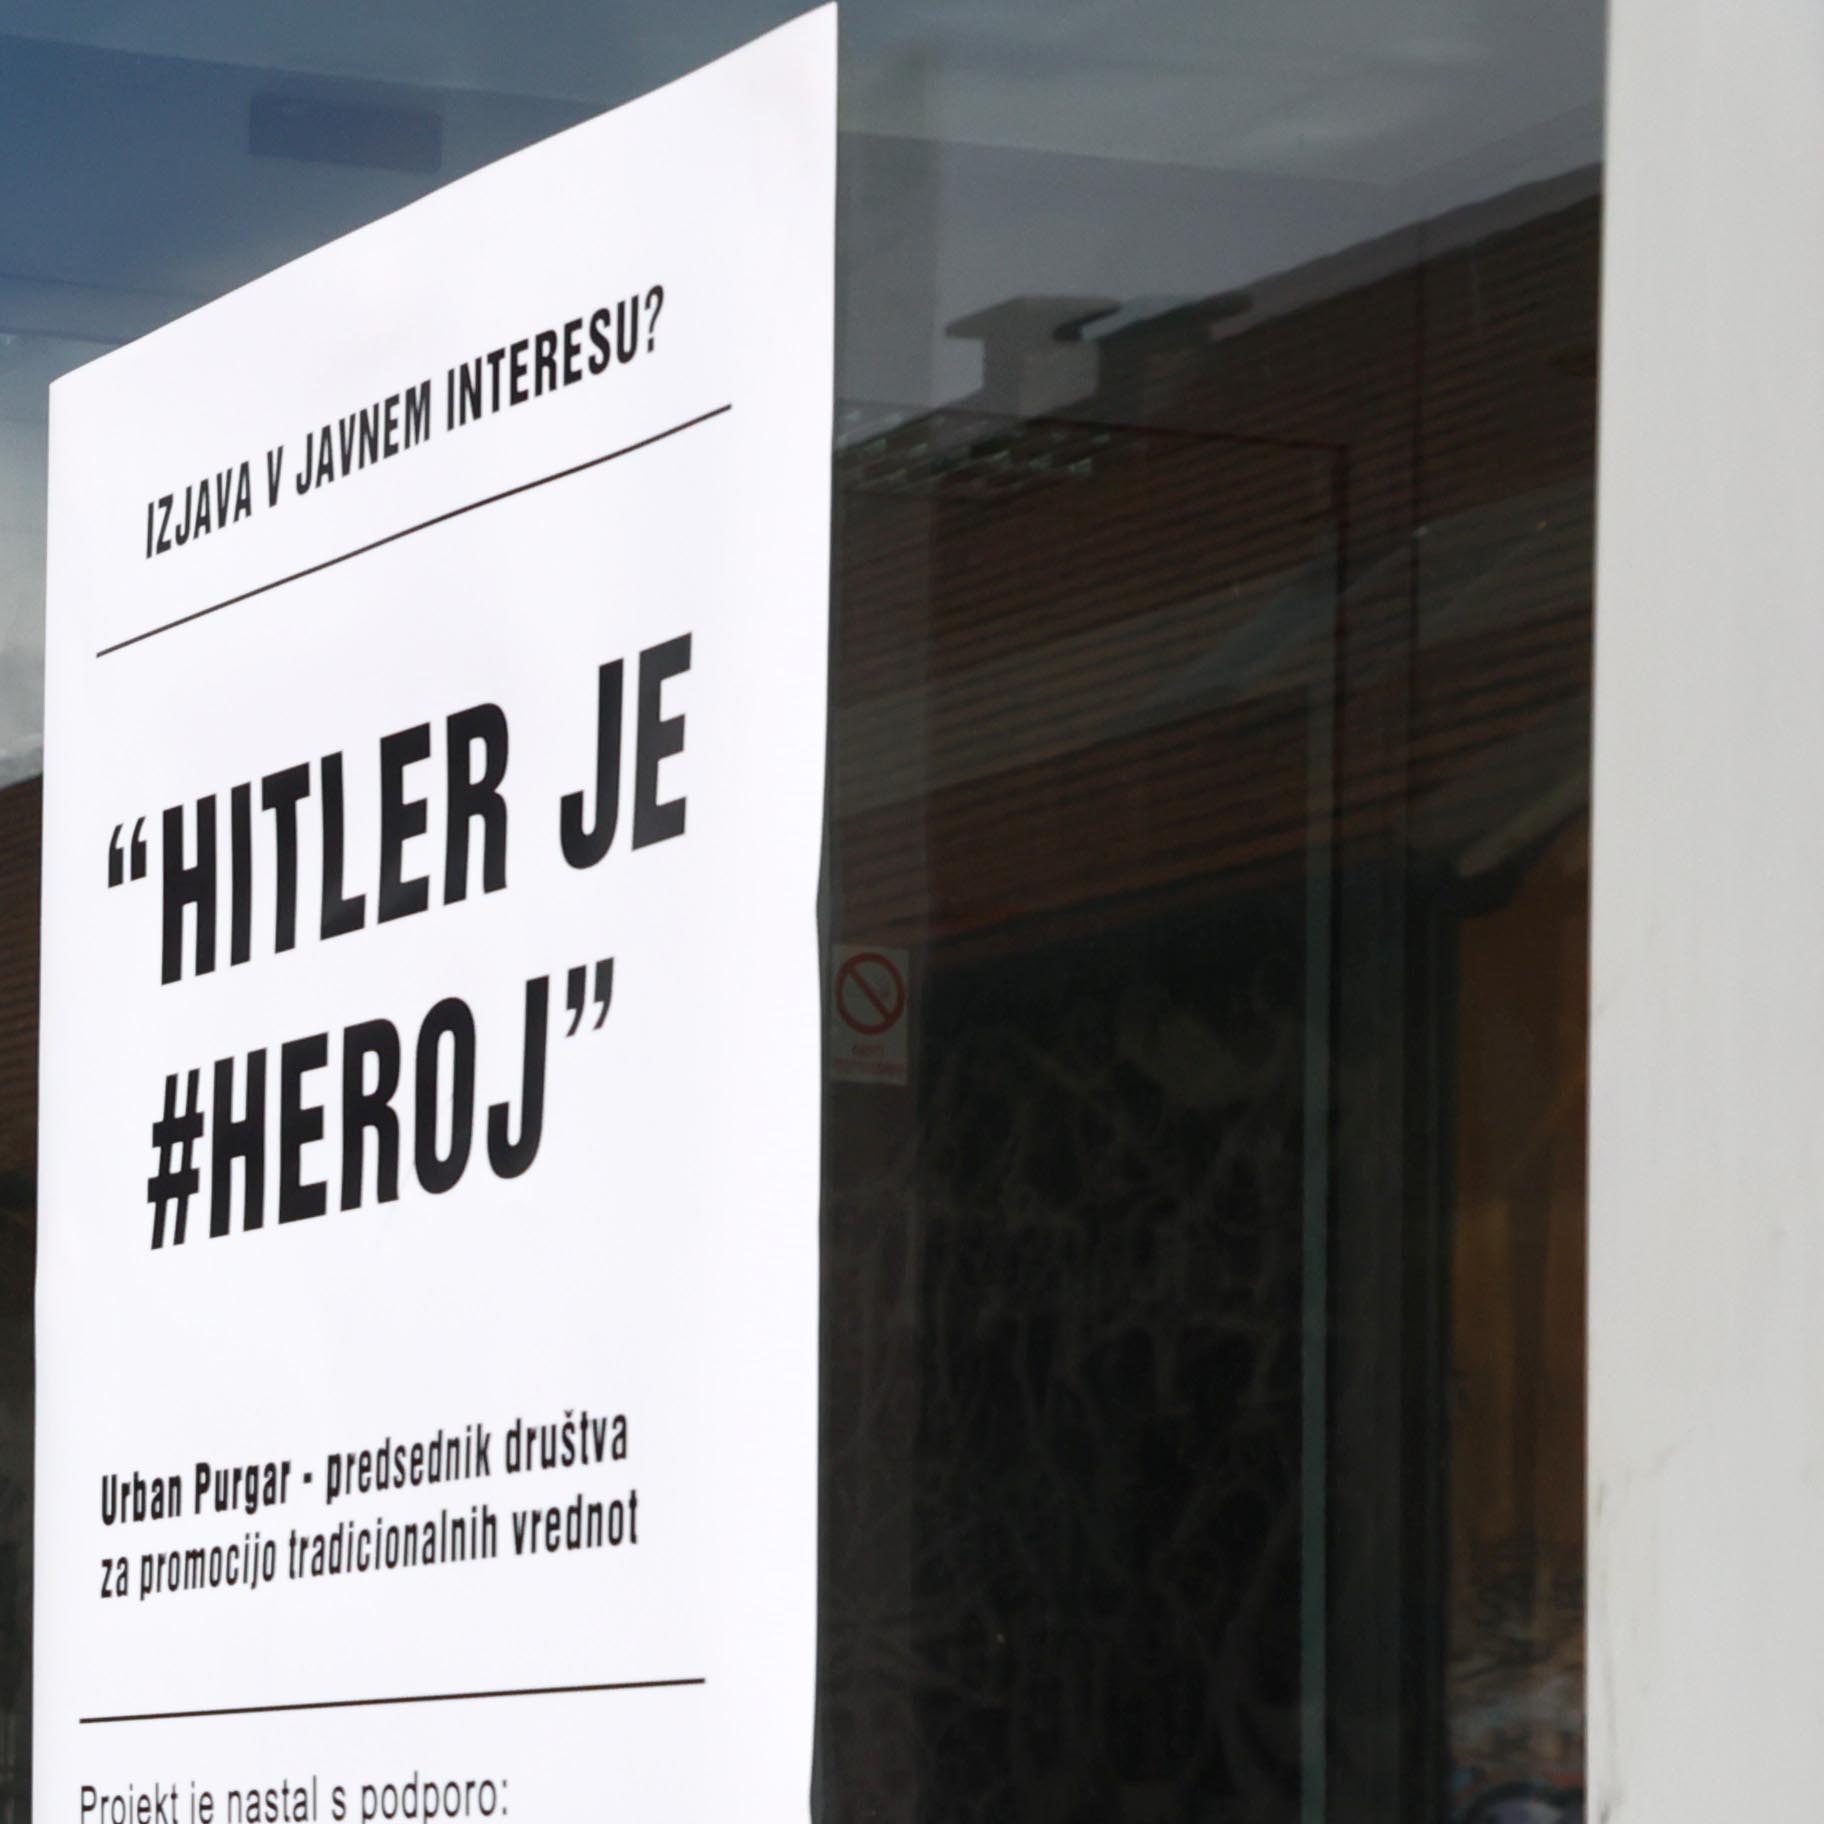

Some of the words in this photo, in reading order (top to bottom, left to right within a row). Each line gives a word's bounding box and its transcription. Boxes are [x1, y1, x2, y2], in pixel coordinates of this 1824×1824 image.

[146, 460, 252, 559] IZJAVA
[266, 445, 284, 508] V
[295, 379, 432, 496] JAVNEM
[446, 284, 665, 432] INTERESU?
[107, 702, 509, 986] “HITLER
[559, 632, 692, 870] JE
[146, 957, 614, 1250] #HEROJ”
[100, 1556, 129, 1599] za
[139, 1531, 277, 1602] promocijo
[288, 1504, 498, 1580] tradicionalnih
[511, 1488, 638, 1556] vrednot
[101, 1470, 182, 1527] Urban
[194, 1460, 291, 1516] Purgar
[325, 1423, 491, 1506] predsednik
[505, 1409, 628, 1475] društva
[227, 1775, 317, 1824] nastal
[331, 1785, 347, 1822] s
